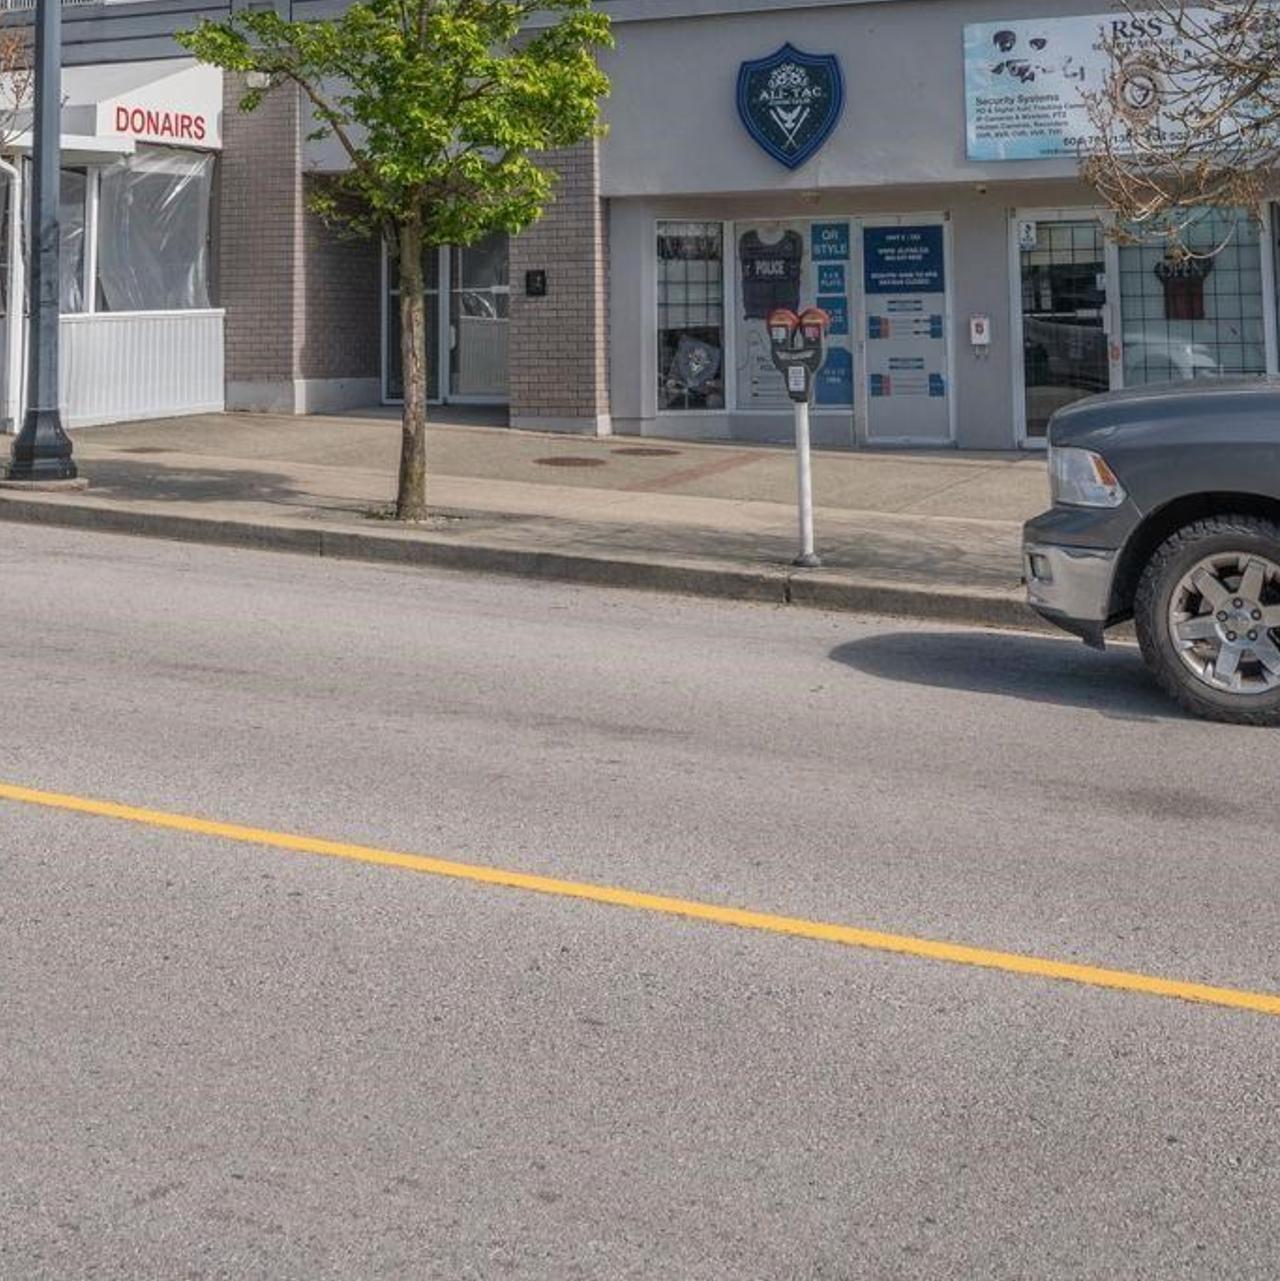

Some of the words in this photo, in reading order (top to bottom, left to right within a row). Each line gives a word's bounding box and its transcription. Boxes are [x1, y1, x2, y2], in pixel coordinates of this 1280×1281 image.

[1111, 18, 1163, 38] RSS
[975, 96, 1015, 107] Security
[1017, 94, 1060, 105] Systems
[115, 107, 206, 140] DONAIRS
[813, 243, 847, 256] STYLE
[754, 260, 786, 276] POLICE
